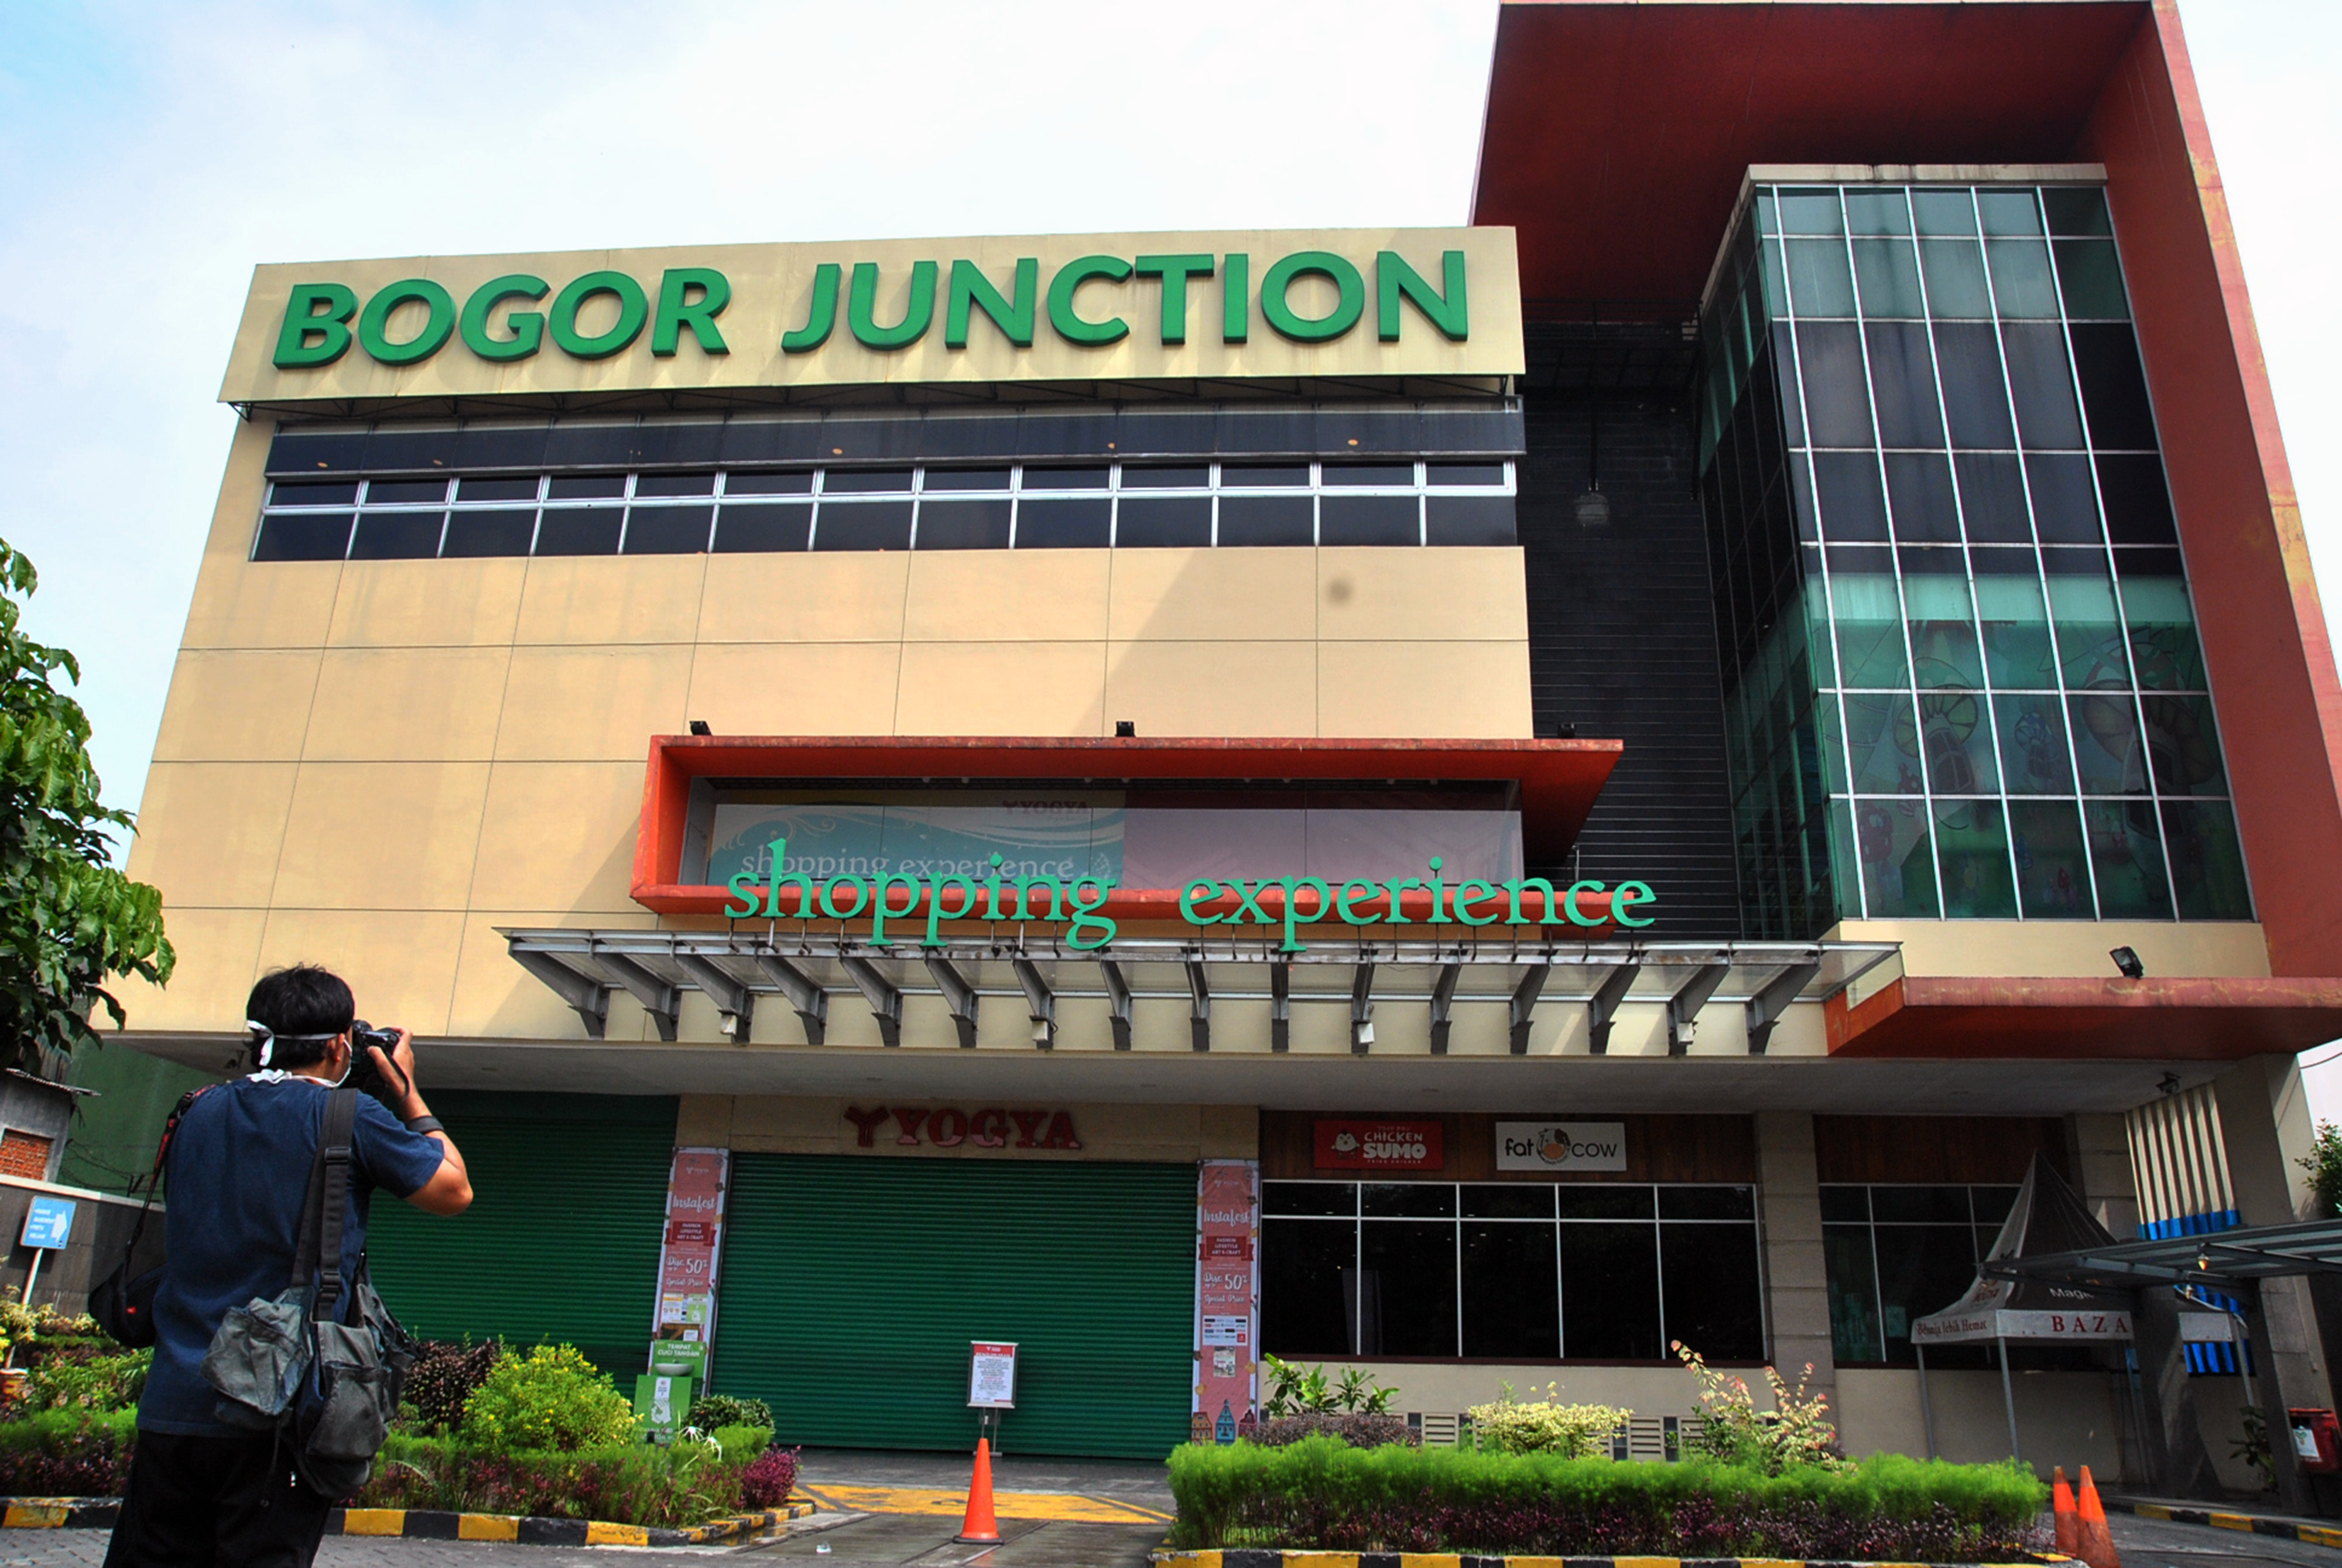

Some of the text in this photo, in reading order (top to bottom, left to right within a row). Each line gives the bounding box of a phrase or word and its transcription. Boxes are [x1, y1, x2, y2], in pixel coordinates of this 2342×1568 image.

[272, 251, 1468, 370] BOGOR JUNCTION
[1020, 800, 1088, 814] YOGYA
[741, 844, 889, 878] shopping
[725, 838, 1655, 951] shopping experience
[891, 1108, 1082, 1149] YOGYA
[1364, 1131, 1423, 1142] CHICKEN
[1362, 1142, 1427, 1159] SUMO
[1505, 1138, 1534, 1156] fat
[673, 1195, 715, 1213] Instafest
[1204, 1208, 1251, 1227] Instafest
[1204, 1294, 1245, 1305] Special Price
[1943, 1320, 1960, 1333] lebih
[1962, 1319, 1987, 1331] Hemat
